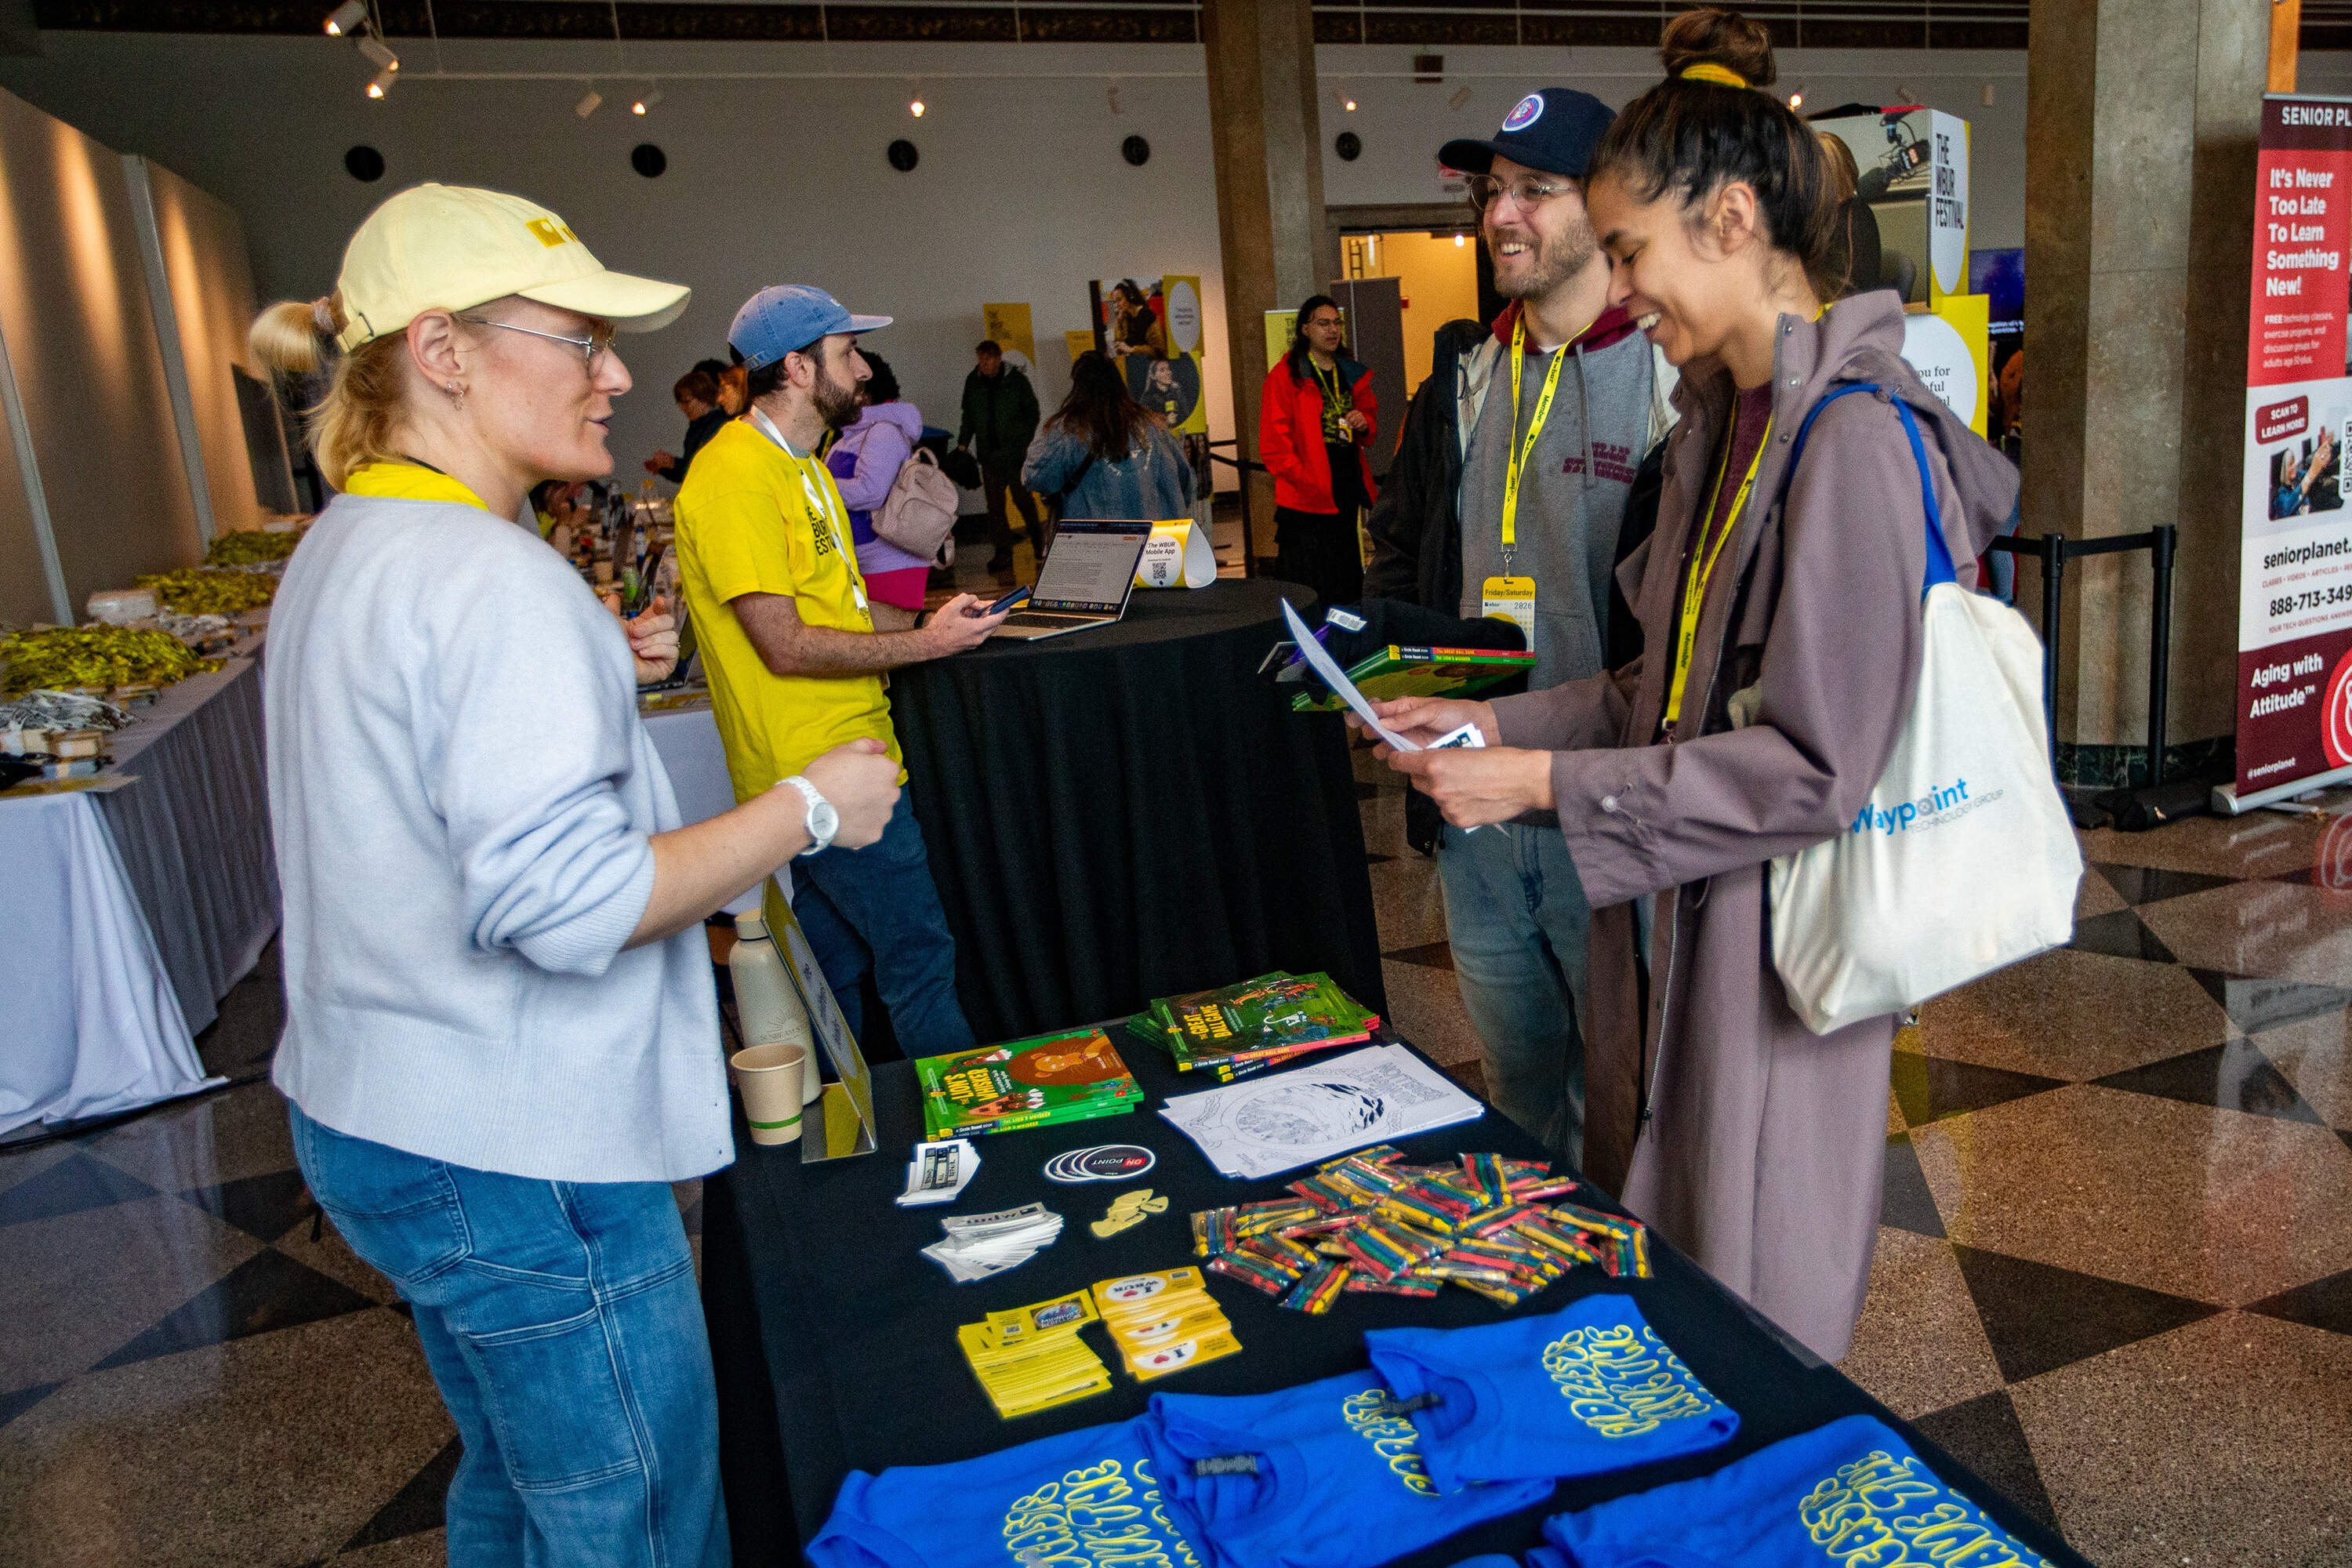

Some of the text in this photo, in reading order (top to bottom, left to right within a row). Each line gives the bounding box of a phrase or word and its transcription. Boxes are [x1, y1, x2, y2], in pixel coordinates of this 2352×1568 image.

[2281, 107, 2333, 125] SENIOR
[1936, 133, 1950, 165] THE
[1936, 165, 1955, 198] WBUR
[2270, 168, 2334, 188] It's Never
[1936, 198, 1964, 230] FESTIVAL
[2269, 195, 2326, 216] Too Late
[2268, 223, 2325, 243] To Learn
[2267, 248, 2339, 270] Something
[2266, 276, 2301, 296] New!
[2264, 314, 2283, 325] FREE
[1935, 366, 1951, 377] for
[1537, 394, 1550, 423] Member
[2270, 403, 2299, 420] SCAN TO
[2261, 424, 2285, 438] LEARN
[2311, 566, 2339, 577] ARTICLES
[1681, 632, 1692, 668] Member
[2251, 652, 2323, 688] Aging with
[1853, 778, 1969, 835] Waypoint
[1909, 789, 2004, 834] TECHNOLOGY GROUP
[1200, 1004, 1223, 1022] GAME
[1184, 1014, 1210, 1035] GREAT
[1209, 1021, 1232, 1038] BALL
[944, 1073, 975, 1100] LION'S
[967, 1068, 1000, 1102] WHISKER
[1031, 1112, 1051, 1120] WHISKER
[1113, 1281, 1158, 1292] WBUR
